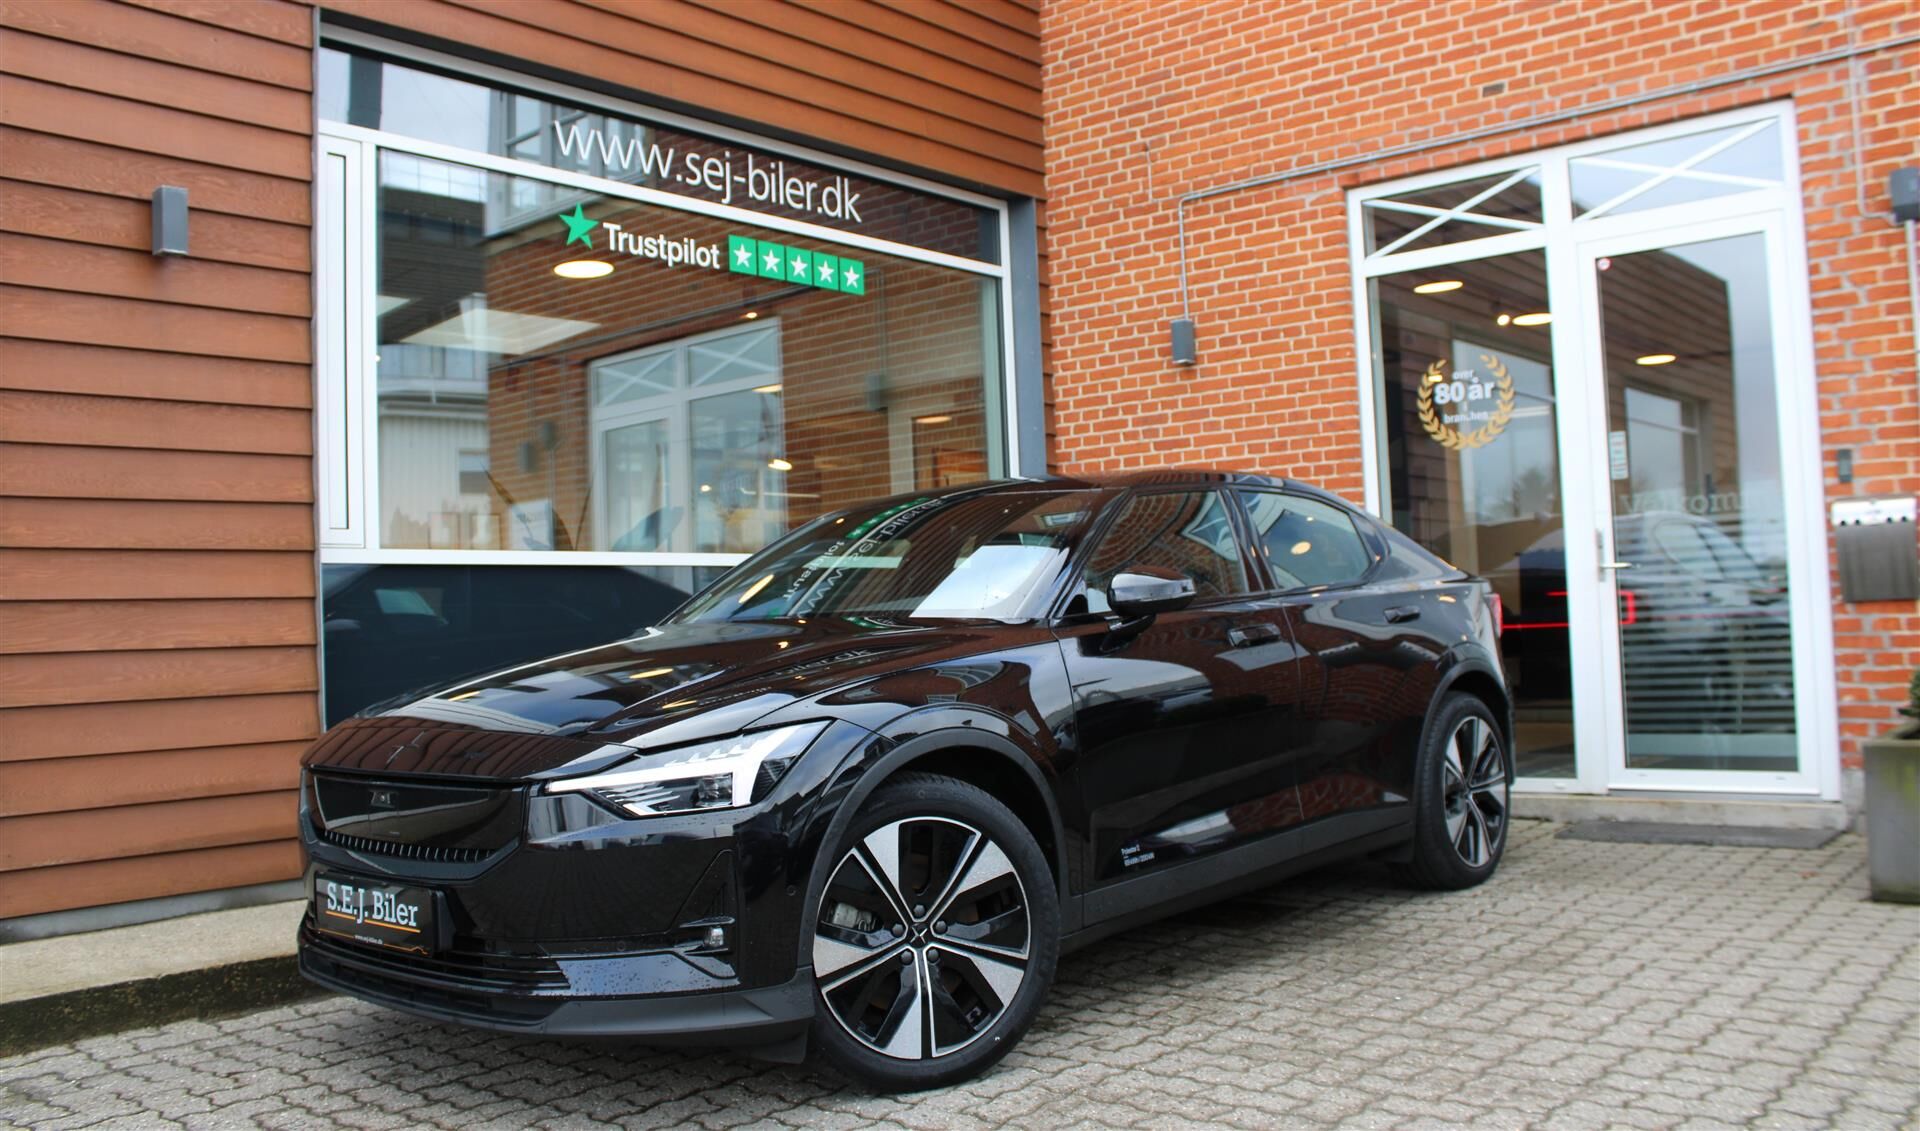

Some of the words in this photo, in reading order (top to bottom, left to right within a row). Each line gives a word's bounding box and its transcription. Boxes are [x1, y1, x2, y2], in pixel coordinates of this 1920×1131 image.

[554, 120, 862, 223] www.sej-biler.dk
[602, 222, 720, 270] Trustpilot
[1434, 381, 1465, 405] 80
[1468, 376, 1495, 401] år
[327, 882, 368, 924] S.E.J.
[372, 890, 418, 927] Biler
